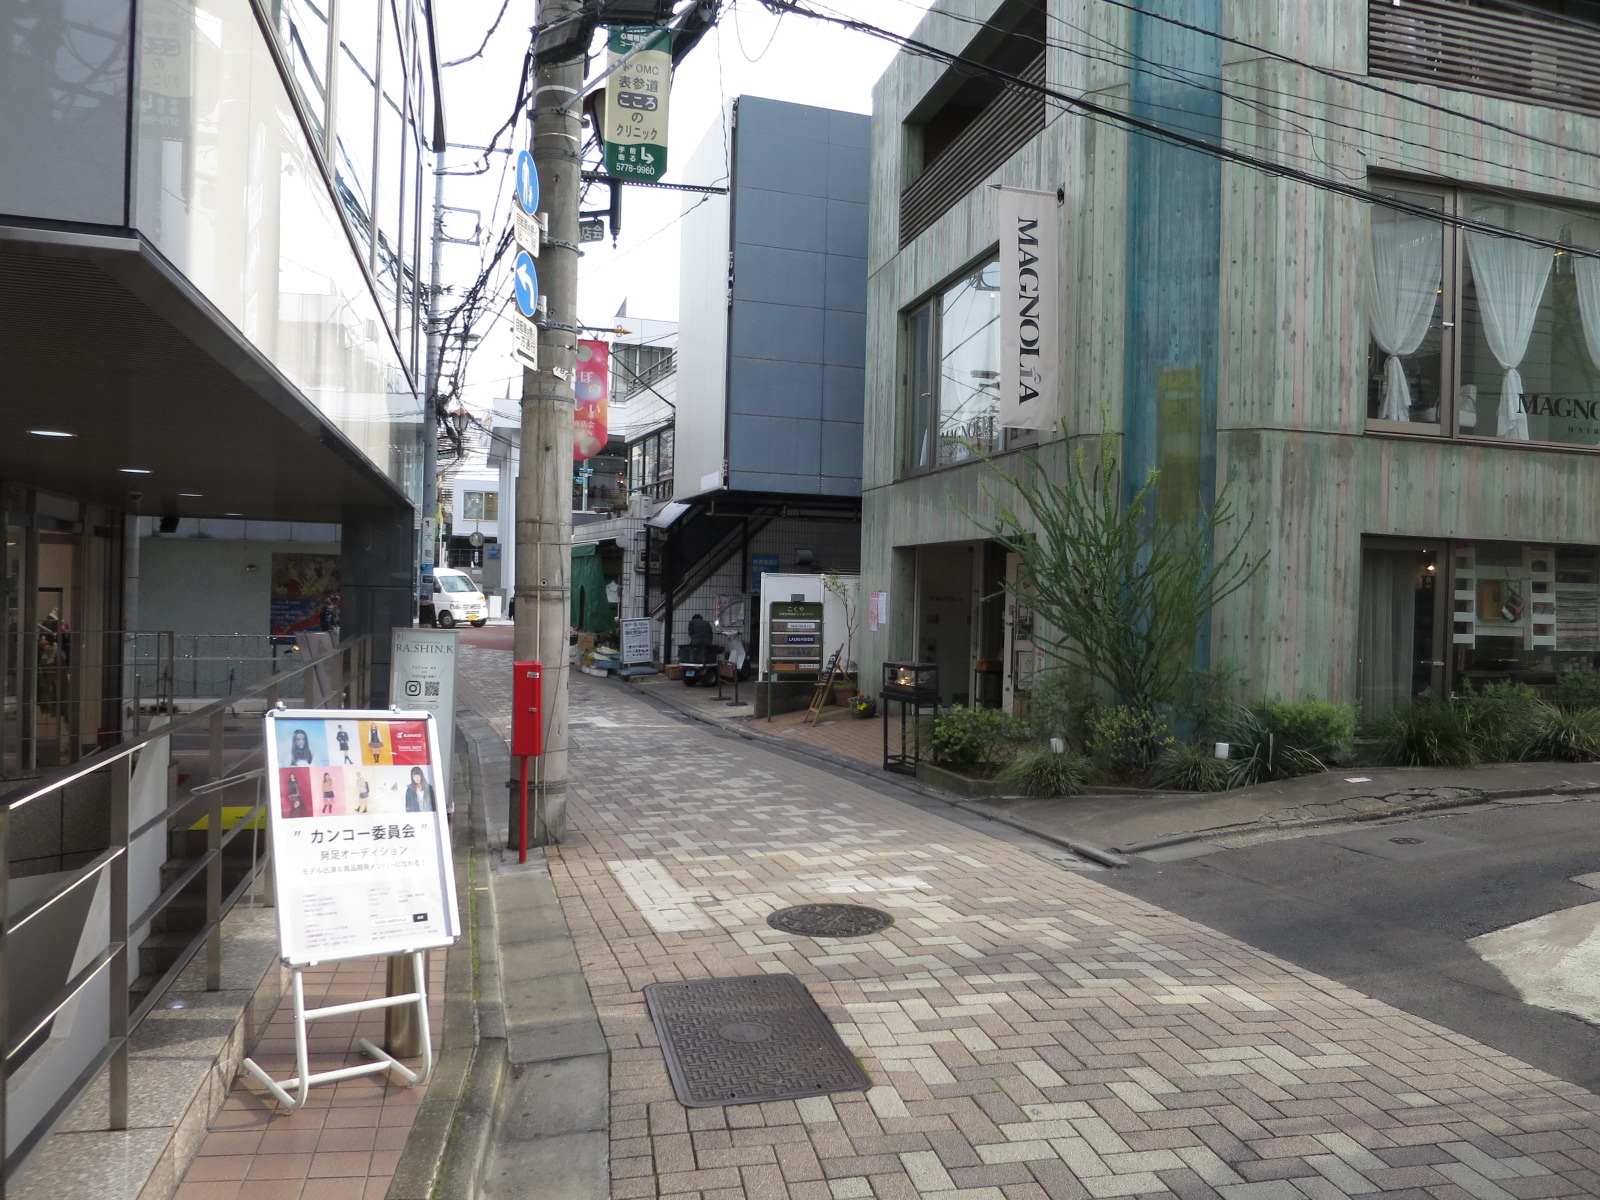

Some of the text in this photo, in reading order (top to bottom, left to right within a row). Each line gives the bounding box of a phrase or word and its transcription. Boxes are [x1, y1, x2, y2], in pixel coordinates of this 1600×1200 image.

[635, 63, 660, 75] OMC
[618, 75, 659, 93] 表参道
[618, 93, 657, 110] こころ
[631, 112, 644, 124] の
[616, 123, 658, 141] クリニック
[616, 163, 655, 176] 5778-9960
[580, 225, 604, 240] 店会
[515, 335, 537, 355] 一方通行
[320, 846, 408, 861] 発足オーディション
